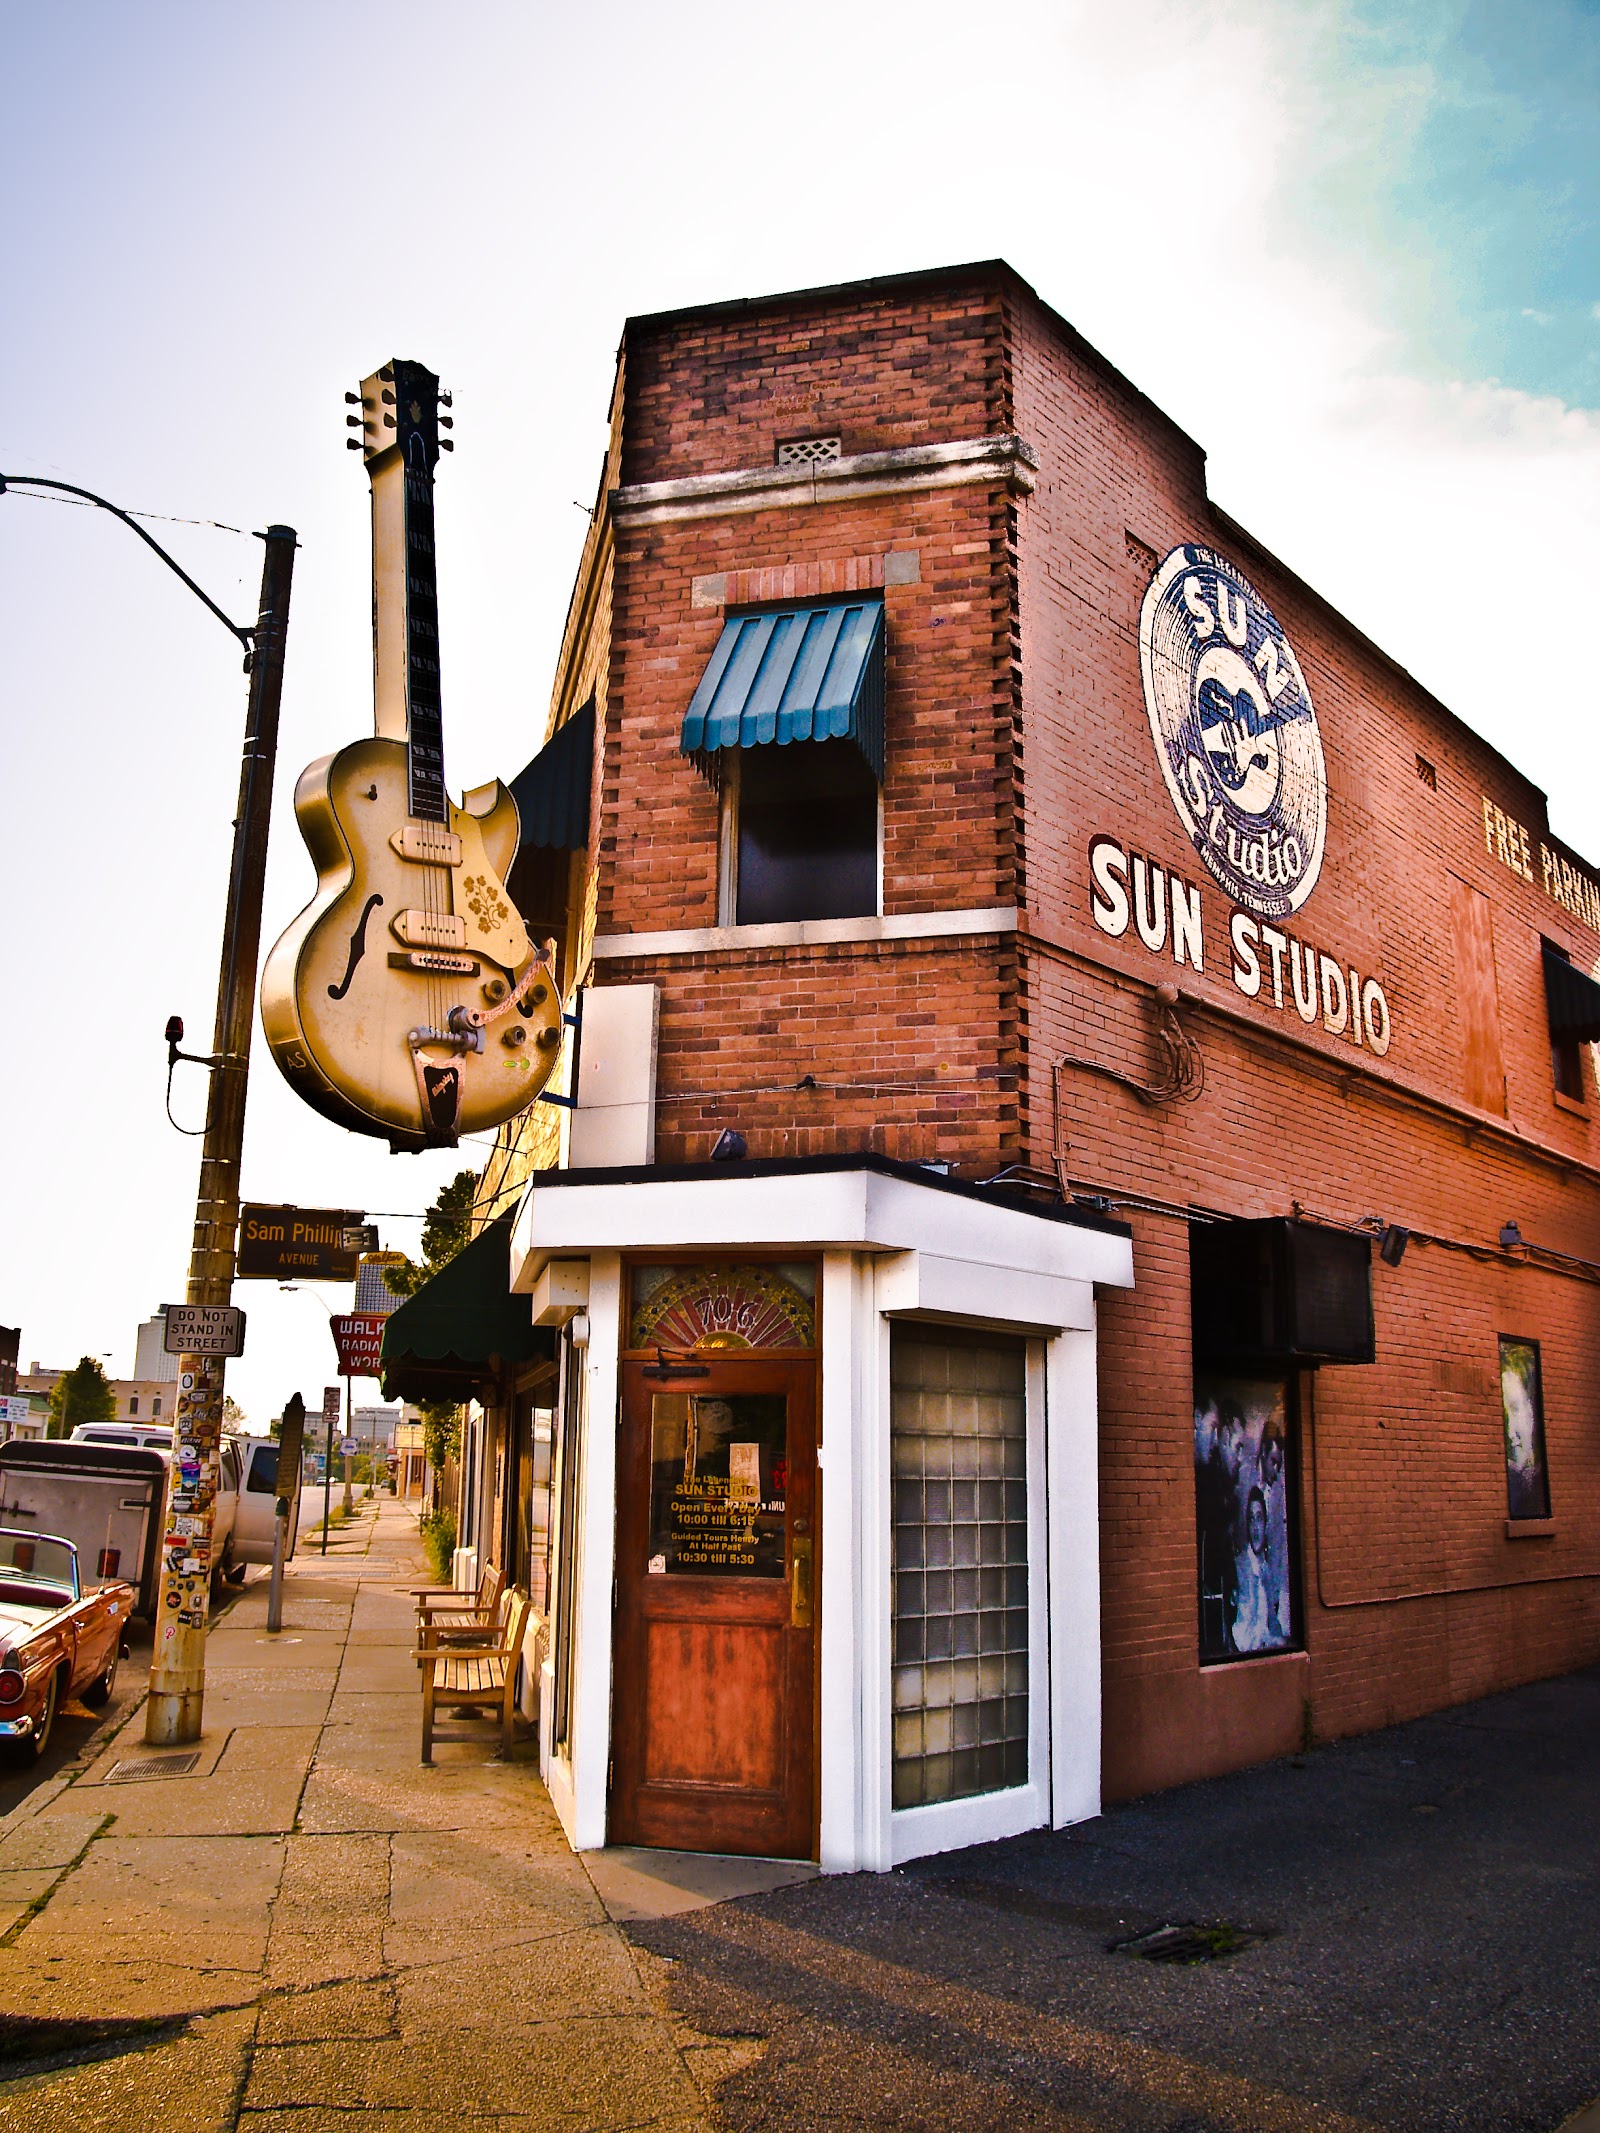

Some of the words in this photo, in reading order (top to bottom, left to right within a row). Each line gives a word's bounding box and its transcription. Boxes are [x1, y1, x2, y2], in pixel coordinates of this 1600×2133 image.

[1183, 575, 1290, 702] SUN
[1178, 754, 1302, 886] Studio
[1482, 795, 1533, 883] FREE
[1243, 892, 1287, 915] TENNESSEE
[1089, 835, 1204, 974] SUN
[1229, 905, 1391, 1057] STUDIO
[246, 1220, 284, 1242] Sam
[292, 1223, 341, 1249] Phillip
[279, 1252, 319, 1266] AVENUE
[178, 1310, 196, 1321] DO
[202, 1311, 229, 1322] NOT
[693, 1294, 755, 1328] 706
[171, 1323, 214, 1335] STAND
[220, 1325, 234, 1336] IN
[340, 1320, 386, 1336] WALK
[176, 1337, 227, 1349] STREET
[341, 1338, 380, 1352] RADIA
[350, 1356, 381, 1368] WOR
[675, 1483, 703, 1496] SUN
[707, 1485, 758, 1498] STUDIO
[670, 1501, 700, 1514] Open
[703, 1502, 736, 1516] Every
[738, 1503, 761, 1517] Day
[676, 1514, 708, 1525] 10:00
[711, 1514, 728, 1526] till
[729, 1515, 756, 1527] 6:15
[671, 1532, 702, 1541] Guided
[703, 1533, 729, 1543] Tours
[730, 1534, 760, 1545] Hourly
[688, 1541, 699, 1550] At
[701, 1542, 720, 1551] Half
[721, 1542, 742, 1552] Past
[676, 1552, 708, 1563] 10:30
[711, 1553, 727, 1564] till
[729, 1554, 756, 1565] 5:30
